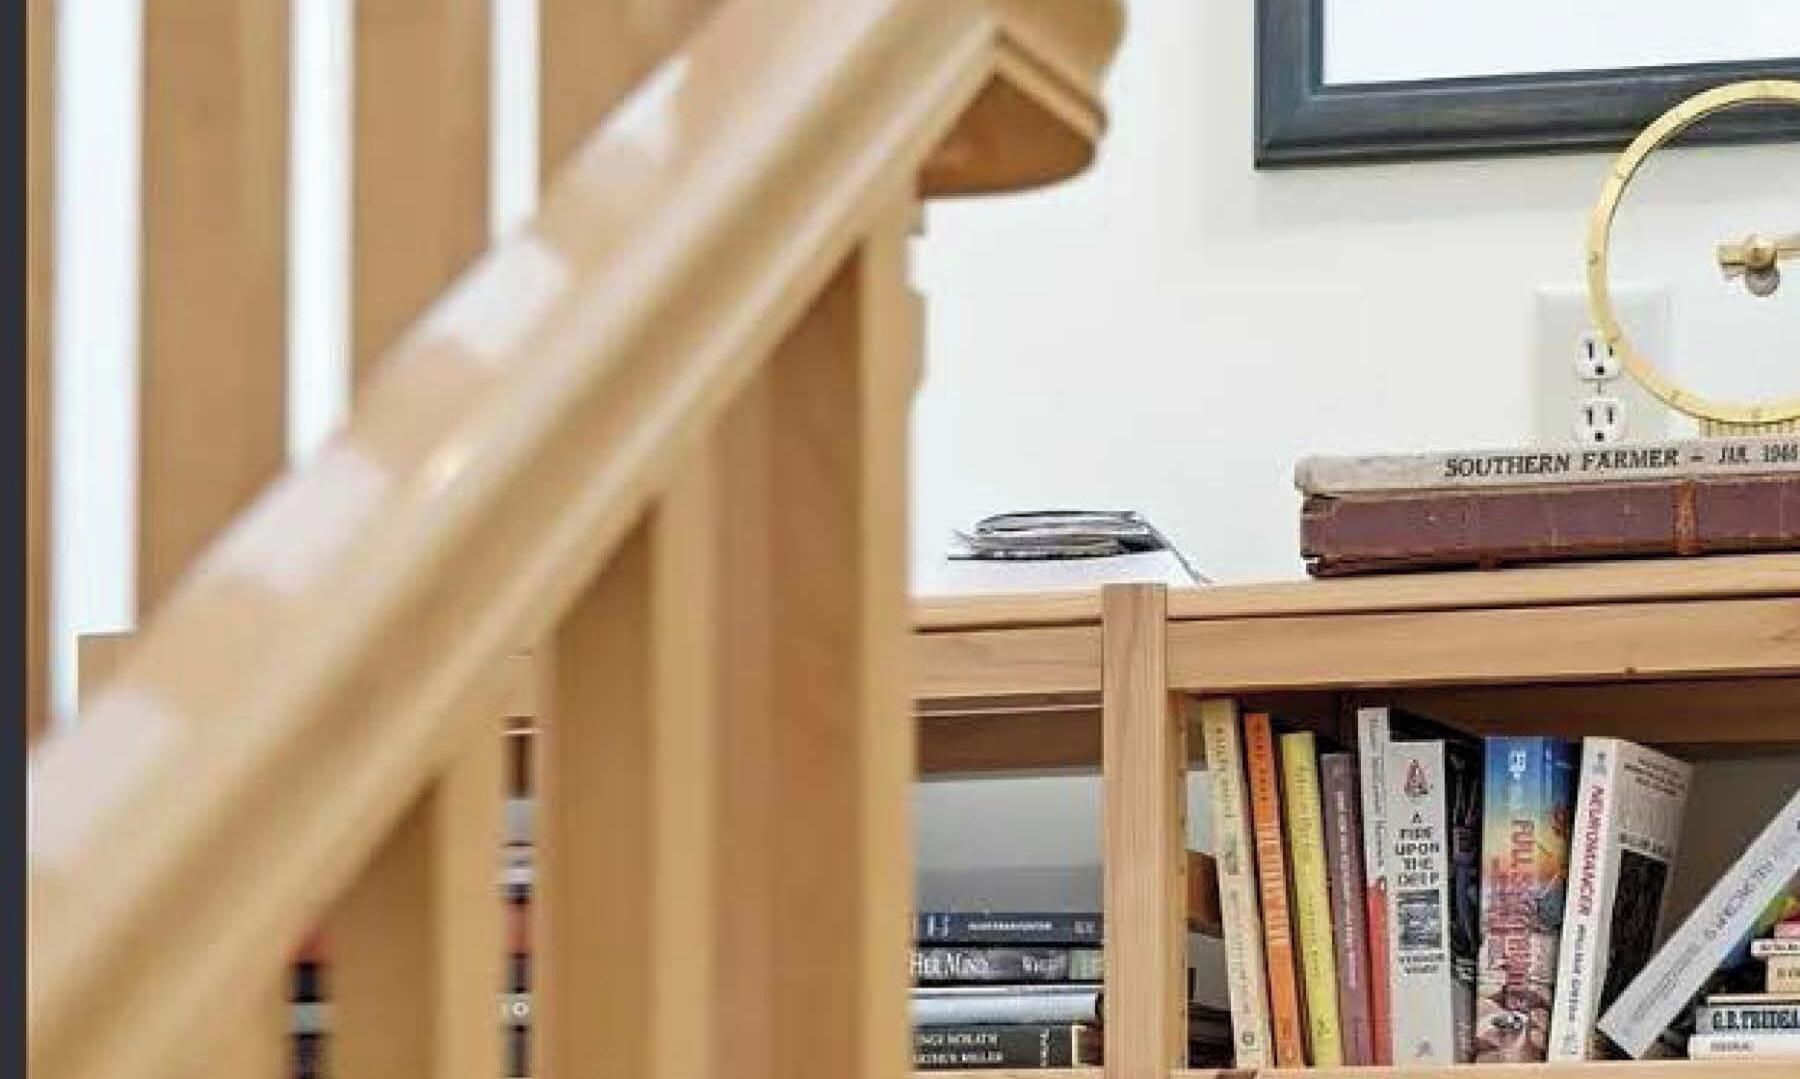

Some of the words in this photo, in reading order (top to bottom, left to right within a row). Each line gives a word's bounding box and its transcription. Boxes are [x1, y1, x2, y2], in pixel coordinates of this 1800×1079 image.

[1445, 454, 1571, 477] SOUTHERN
[1581, 448, 1679, 472] FARMER
[1577, 785, 1605, 916] NEUROMANCER
